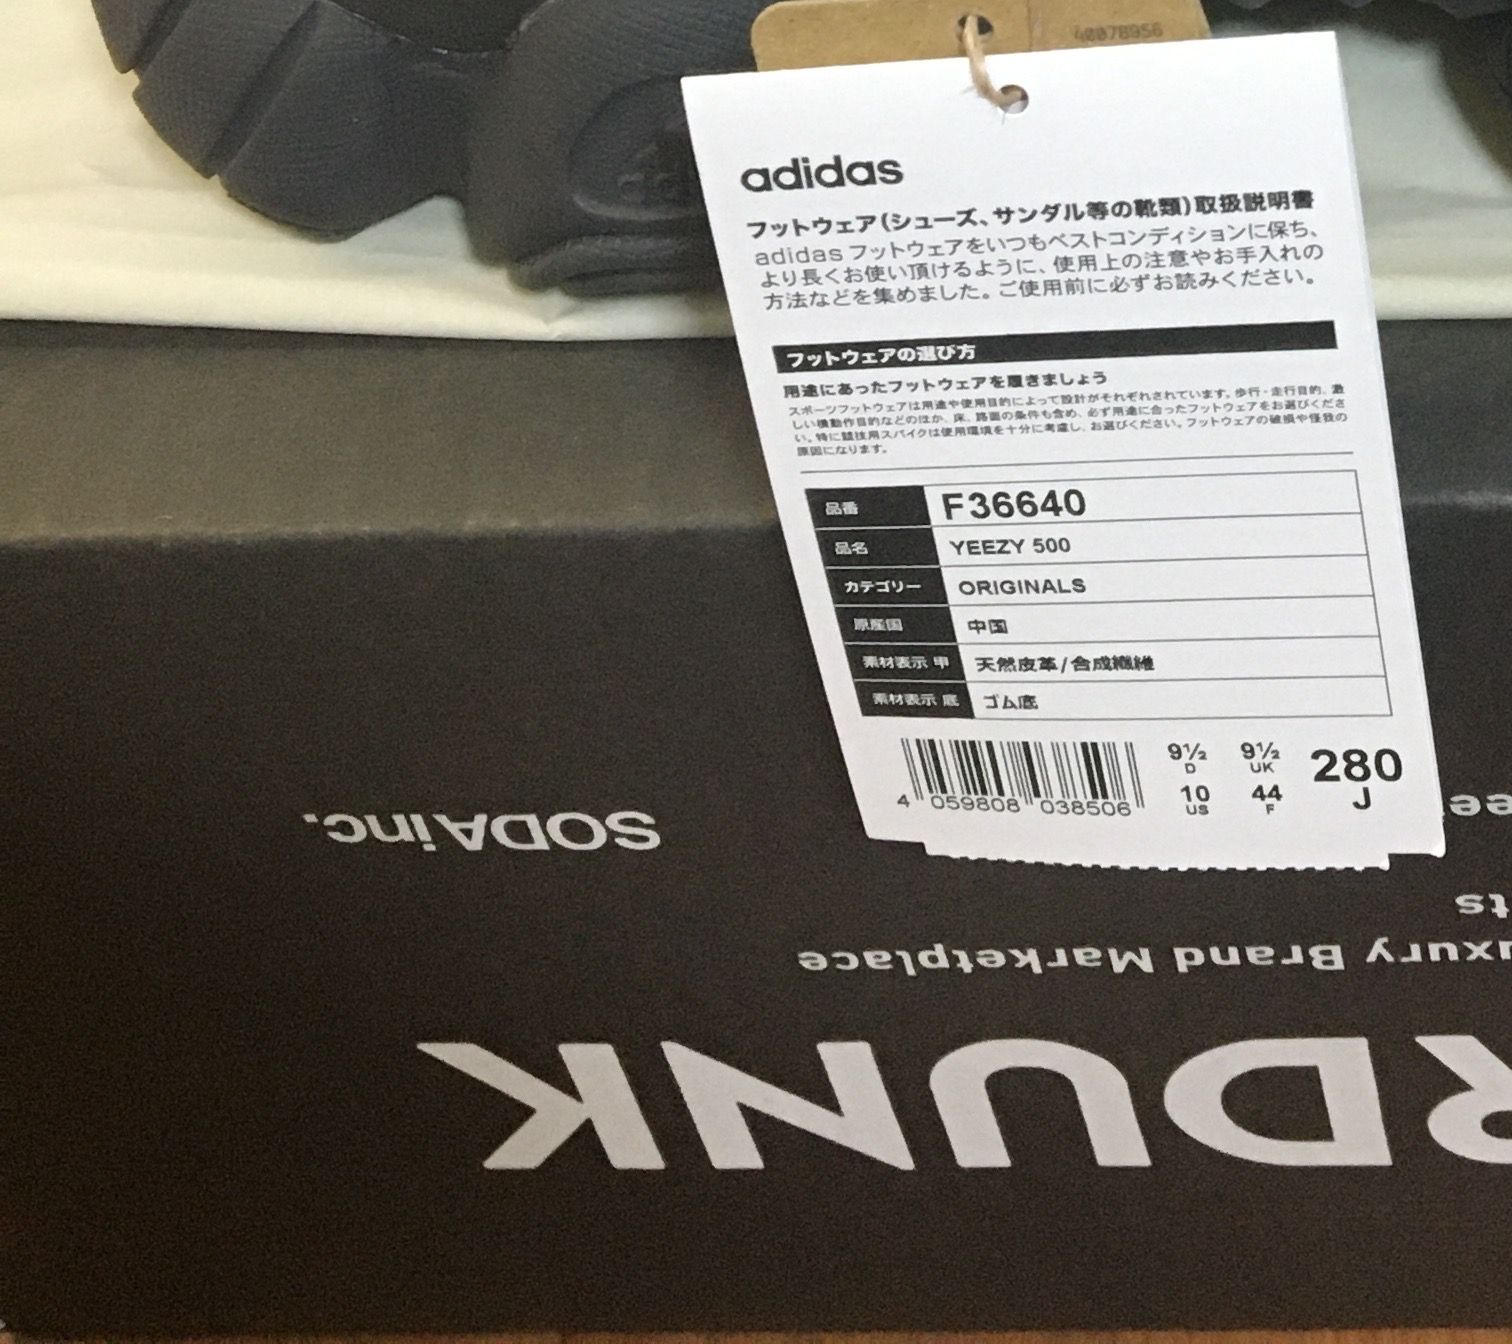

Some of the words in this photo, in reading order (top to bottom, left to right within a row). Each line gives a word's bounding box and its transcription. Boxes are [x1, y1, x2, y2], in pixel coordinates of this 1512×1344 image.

[740, 154, 904, 192] adidas
[755, 246, 844, 266] adidas
[760, 243, 1324, 289] より長くお使い頂けるように、使用上の注意やお手入れの
[762, 266, 1315, 311] 方法などを集めました。ご使用前に必ずお読みください。
[786, 343, 977, 369] フットウェアの選び方
[783, 370, 1108, 400] 用途にあったフットウェアを履きましょう
[796, 443, 888, 457] 原因になります。
[825, 501, 858, 516] 品番
[941, 488, 1087, 521] F36640
[835, 541, 868, 556] 品名
[950, 539, 1025, 556] YEEZY
[1033, 537, 1071, 554] 500
[844, 580, 922, 594] カテゴリー
[958, 578, 1087, 596] ORIGINALS
[853, 618, 903, 633] 原産国
[967, 619, 1008, 635] 中国
[862, 655, 928, 670] 素材表示
[974, 655, 1155, 673] 天然皮革/合成繊維
[871, 692, 938, 707] 素材表示
[983, 695, 1039, 710] ゴム底
[1184, 763, 1196, 775] D
[1250, 762, 1275, 775] UK
[1310, 748, 1403, 783] 280
[1179, 785, 1210, 803] 10
[1252, 784, 1283, 802] 44
[1352, 787, 1373, 811] J
[896, 794, 911, 808] 4
[930, 794, 1020, 813] 059808
[1040, 797, 1132, 817] 038506
[1185, 803, 1209, 816] US
[1266, 804, 1275, 816] F
[797, 942, 1155, 977] Marketplace
[1172, 943, 1345, 973] Brand
